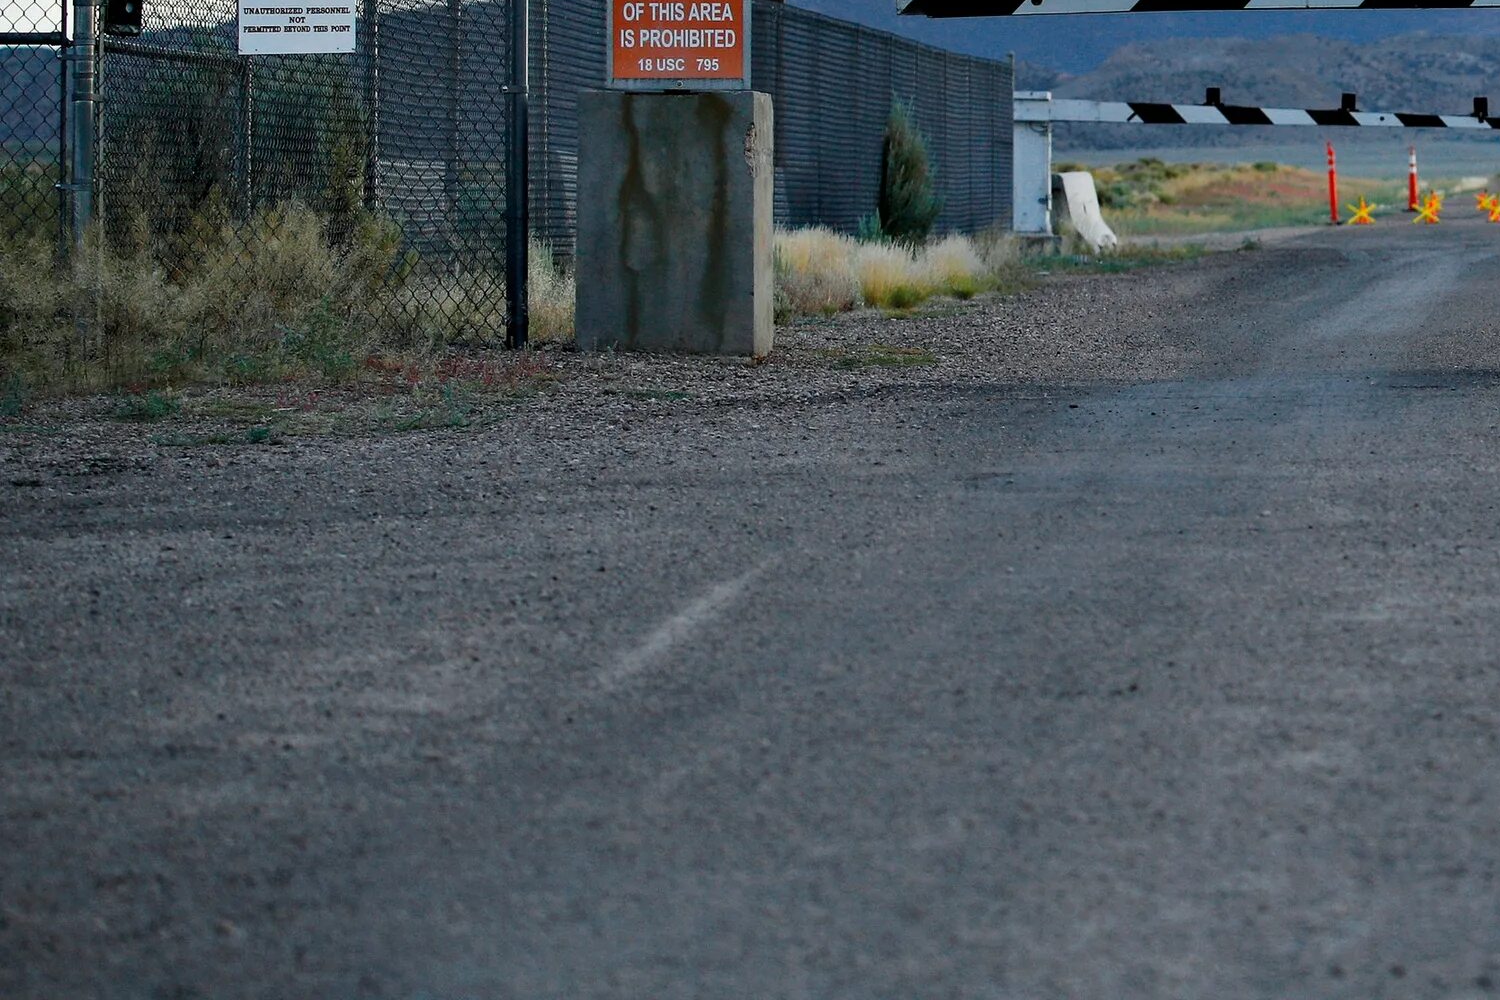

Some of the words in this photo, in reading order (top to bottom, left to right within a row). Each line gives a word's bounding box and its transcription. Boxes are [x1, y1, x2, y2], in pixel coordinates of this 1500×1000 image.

[244, 7, 303, 15] UNAUTHORIZED
[306, 7, 350, 15] PERSONNEL
[623, 3, 644, 21] OF
[649, 3, 684, 21] THIS
[688, 3, 733, 21] AREA
[621, 29, 635, 47] IS
[640, 29, 736, 48] PROHIBITED
[638, 58, 653, 71] 18
[657, 58, 685, 71] USC
[697, 58, 719, 71] 795
